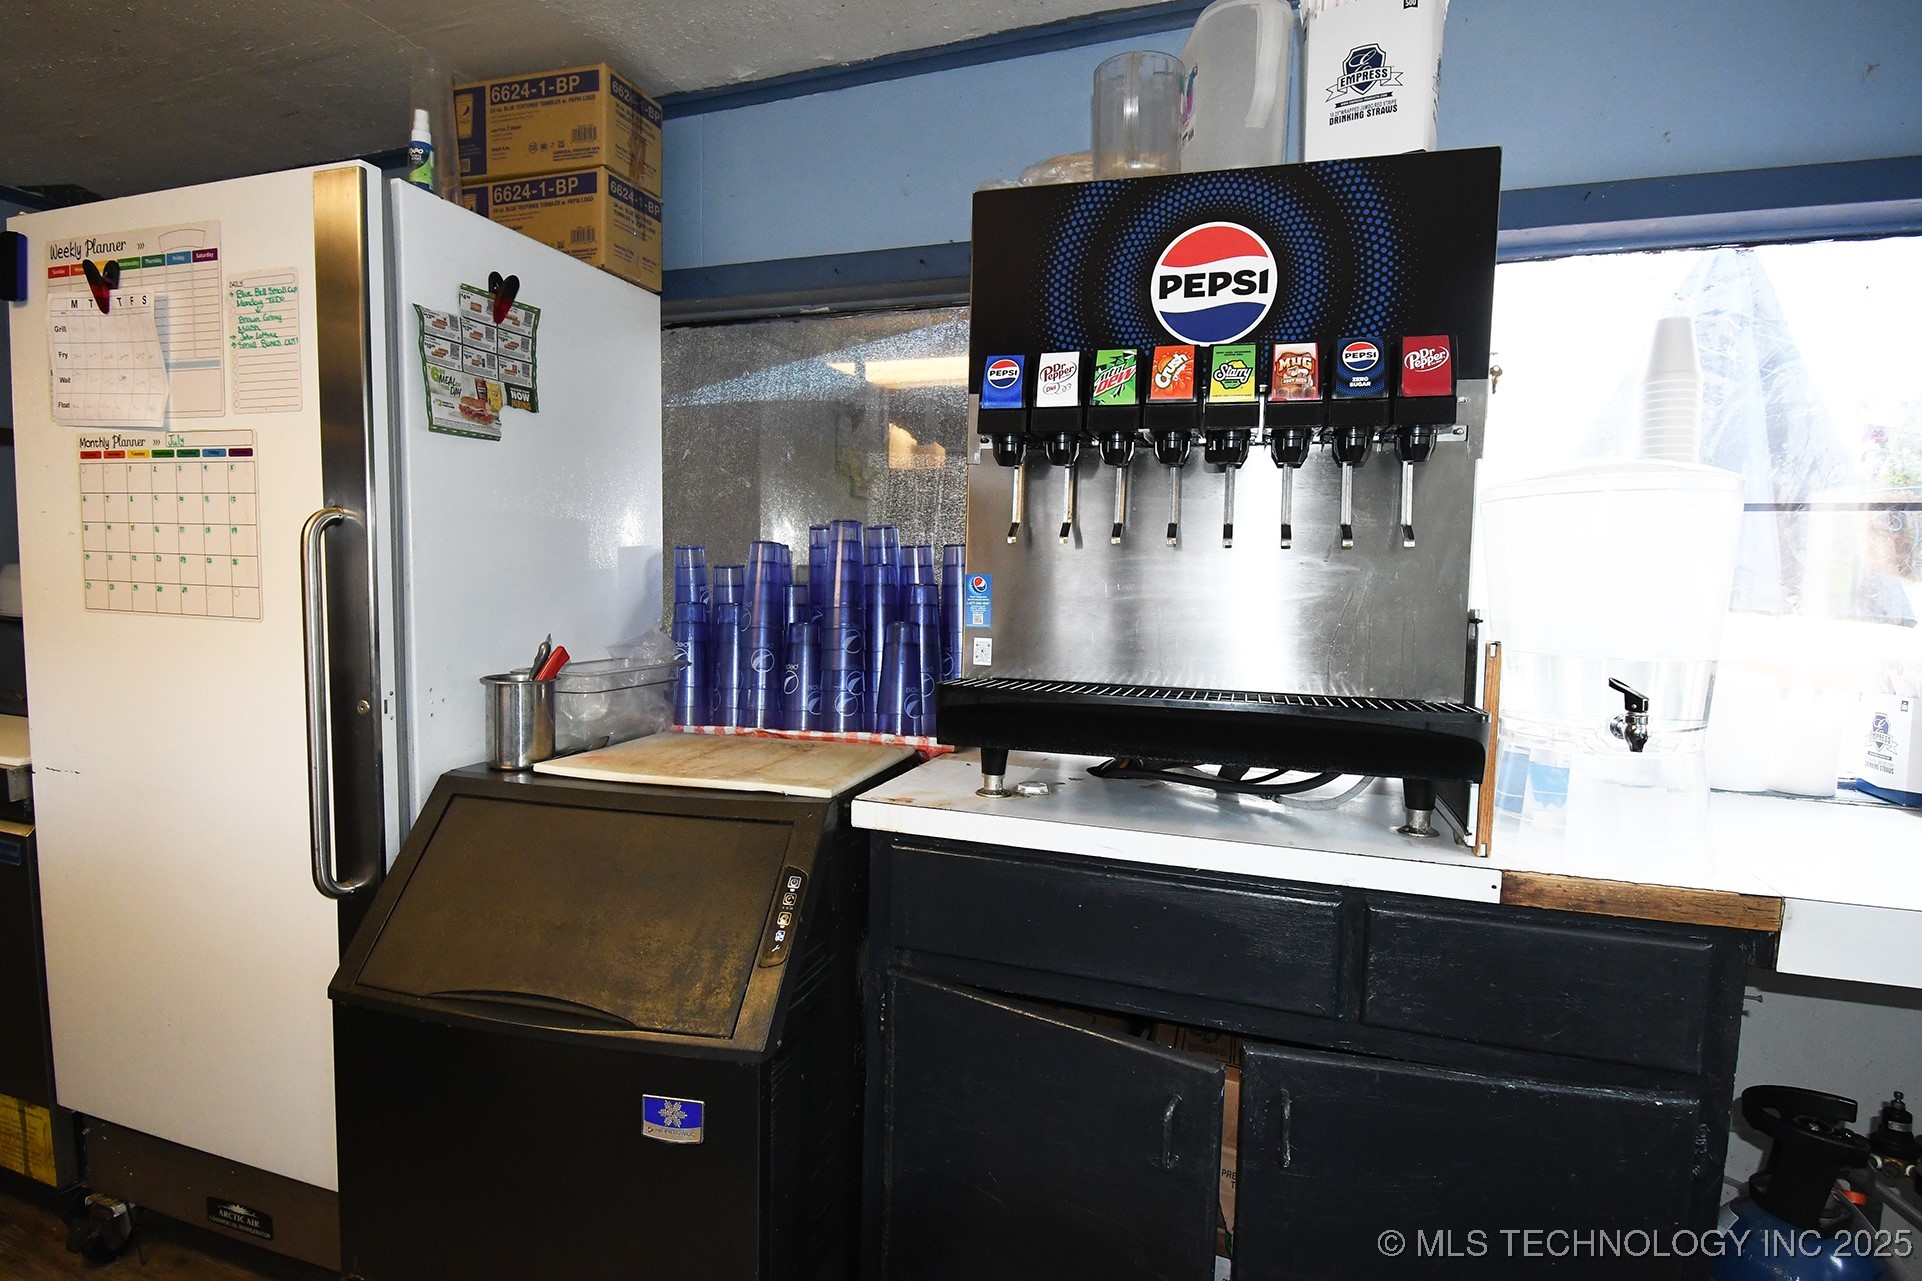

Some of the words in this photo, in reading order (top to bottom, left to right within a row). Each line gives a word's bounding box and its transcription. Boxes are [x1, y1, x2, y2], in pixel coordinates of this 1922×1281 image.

[1340, 69, 1388, 87] EMPRESS
[490, 75, 581, 102] 6624-1-BP
[1329, 111, 1364, 126] DRINKING
[1367, 105, 1398, 117] STRAWS
[494, 177, 579, 202] 6624-1-BP
[610, 181, 660, 215] 6624-1-BP
[50, 242, 82, 260] Weekly
[85, 238, 127, 257] Planner
[196, 251, 214, 259] Saturday
[1158, 268, 1269, 300] PEPSI
[236, 290, 252, 299] Blue
[255, 287, 266, 296] Bell
[268, 286, 286, 295] Small
[71, 300, 78, 308] M
[89, 300, 94, 308] T
[117, 298, 122, 306] T
[130, 297, 134, 306] F
[142, 295, 147, 305] S
[238, 316, 260, 324] Brown
[1345, 351, 1376, 359] PEPSI
[1407, 352, 1446, 370] Pepper
[1419, 348, 1436, 360] Dr
[1054, 363, 1066, 372] Dr
[1155, 353, 1190, 388] Crush
[1278, 357, 1312, 372] MUG
[439, 374, 456, 386] MEAL
[1043, 366, 1074, 382] Pepper
[1214, 364, 1252, 384] Starry
[511, 391, 530, 401] NOW
[80, 437, 109, 450] Monthly
[112, 434, 146, 449] Planner
[167, 434, 185, 448] July
[218, 1209, 245, 1223] ARCTIC
[246, 1218, 260, 1228] AIR
